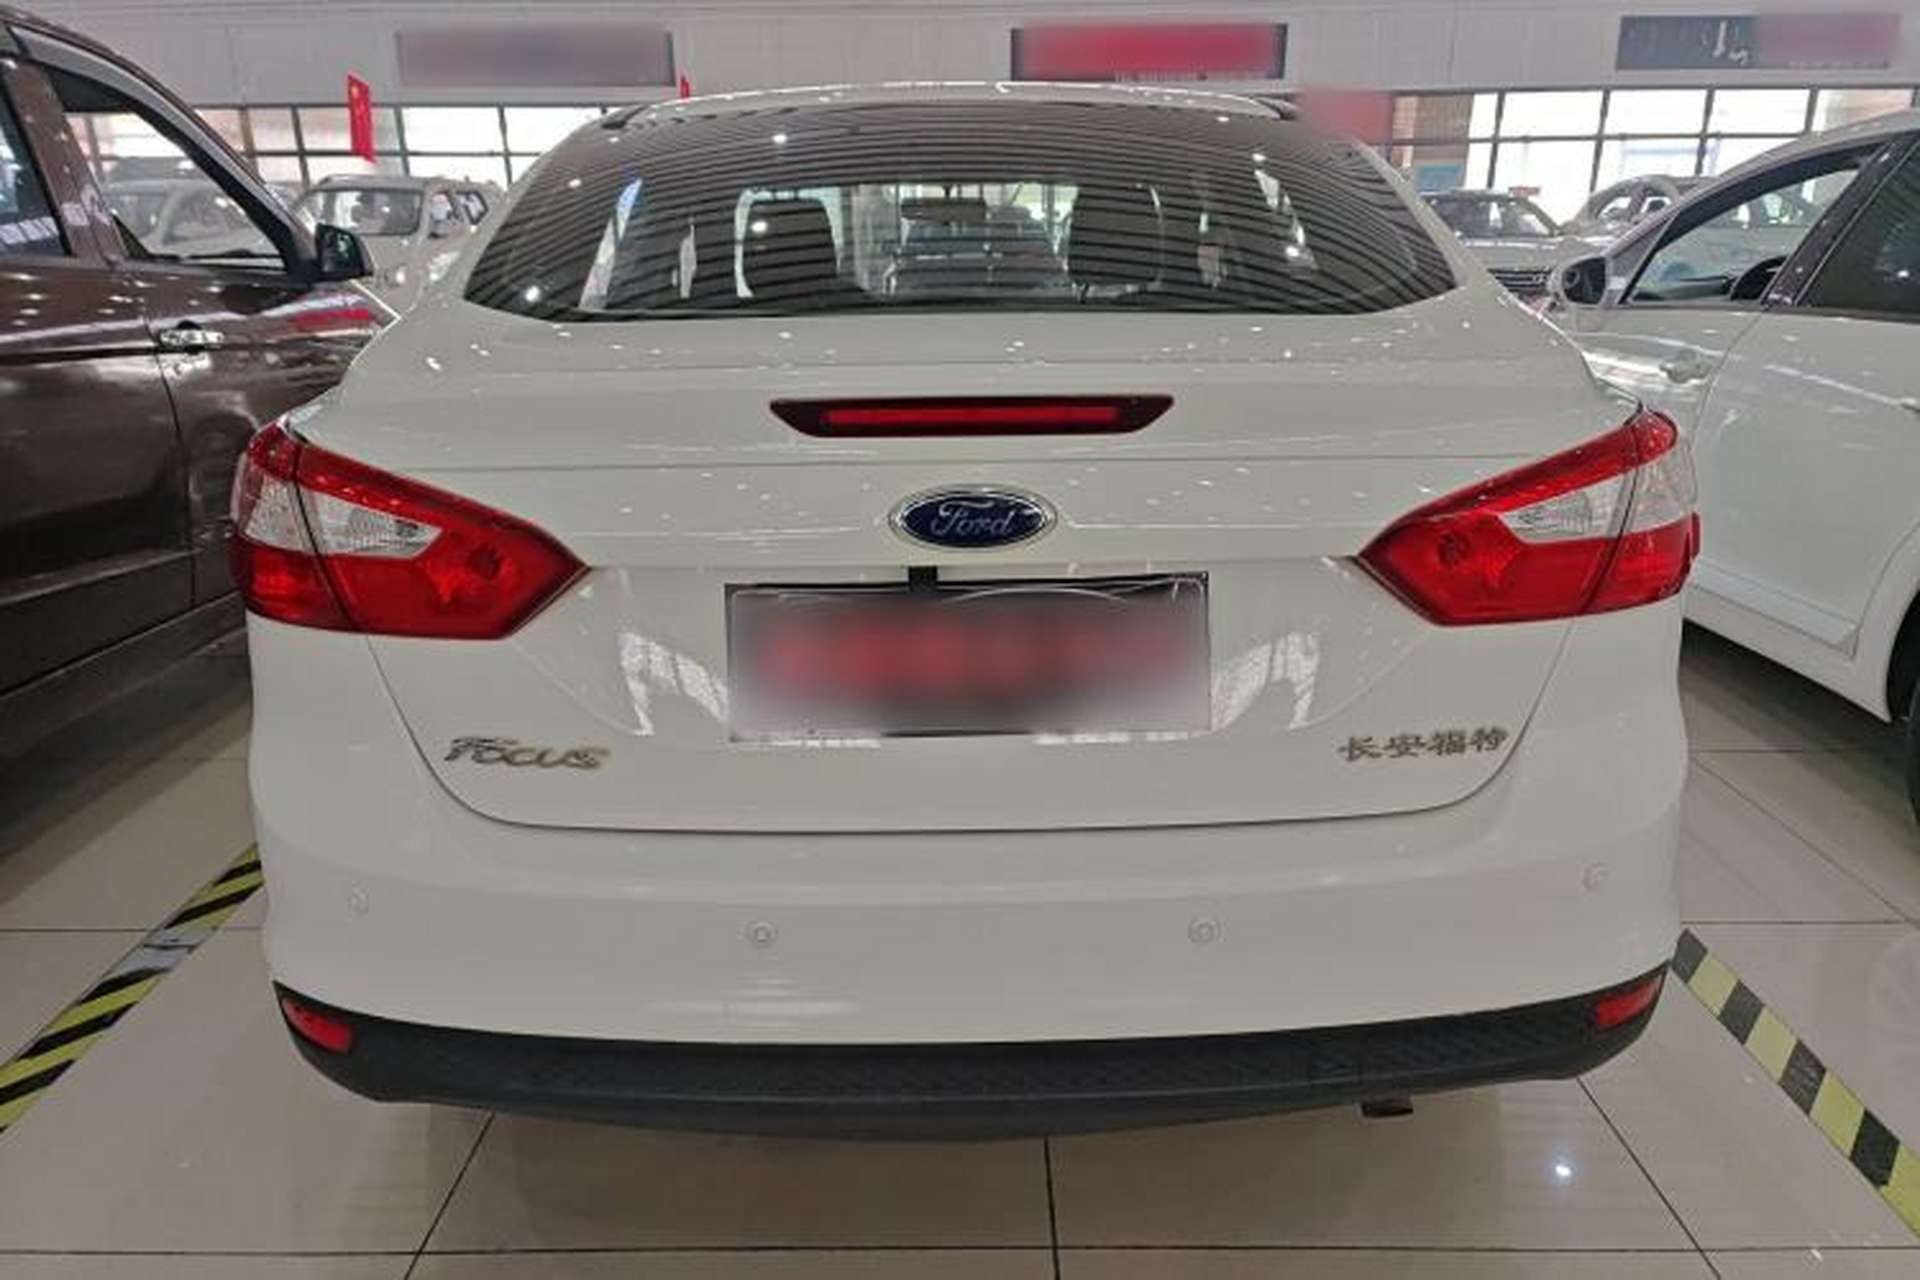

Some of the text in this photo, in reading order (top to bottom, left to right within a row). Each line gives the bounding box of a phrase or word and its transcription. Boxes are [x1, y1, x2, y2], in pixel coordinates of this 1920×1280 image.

[930, 500, 1016, 536] Ford
[1338, 728, 1508, 761] 长安福特
